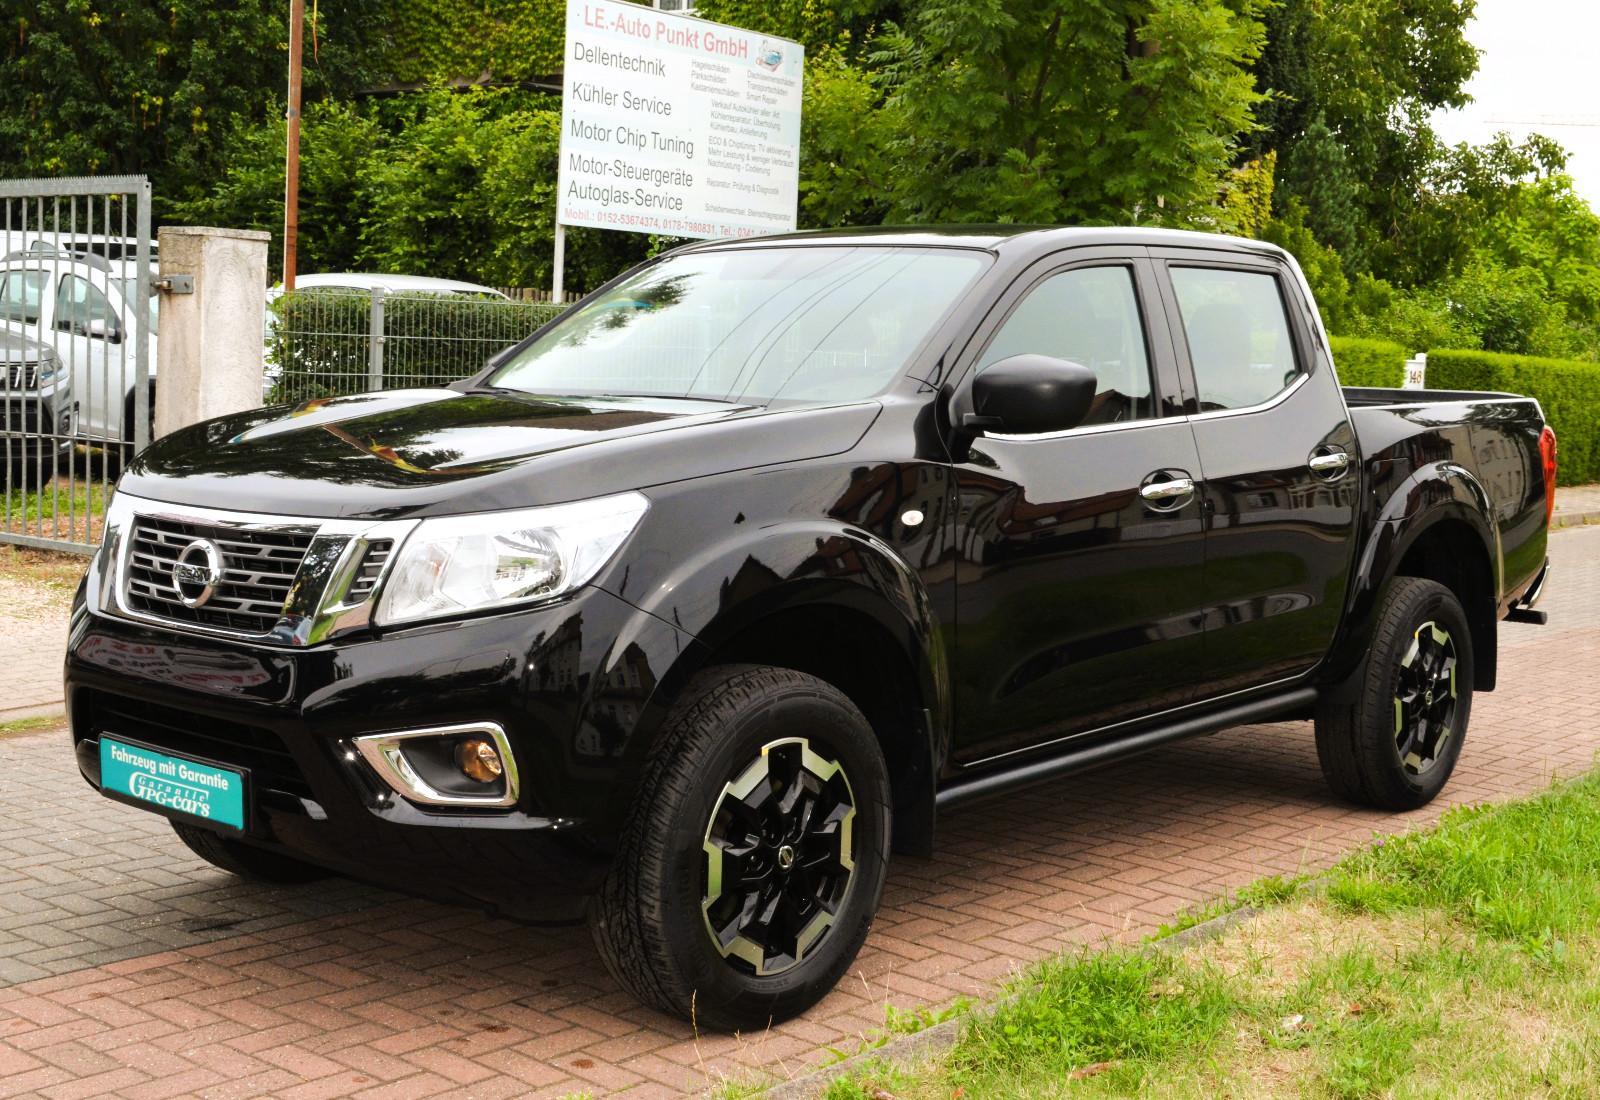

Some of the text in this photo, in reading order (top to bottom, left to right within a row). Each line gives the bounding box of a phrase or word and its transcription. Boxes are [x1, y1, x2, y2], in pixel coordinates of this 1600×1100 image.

[656, 21, 699, 49] Punkt
[704, 32, 748, 58] GmbH
[574, 42, 666, 77] Dellentechnik
[572, 81, 672, 116] Kühler Service
[571, 118, 694, 159] Motor Chip Tuning
[569, 153, 693, 187] Motor-Steuergeräte
[567, 180, 683, 211] Autoglas-Service
[111, 745, 229, 791] Fahrzeug mit Garantie
[129, 771, 210, 818] GPG-cars
[138, 776, 206, 802] Garantie
